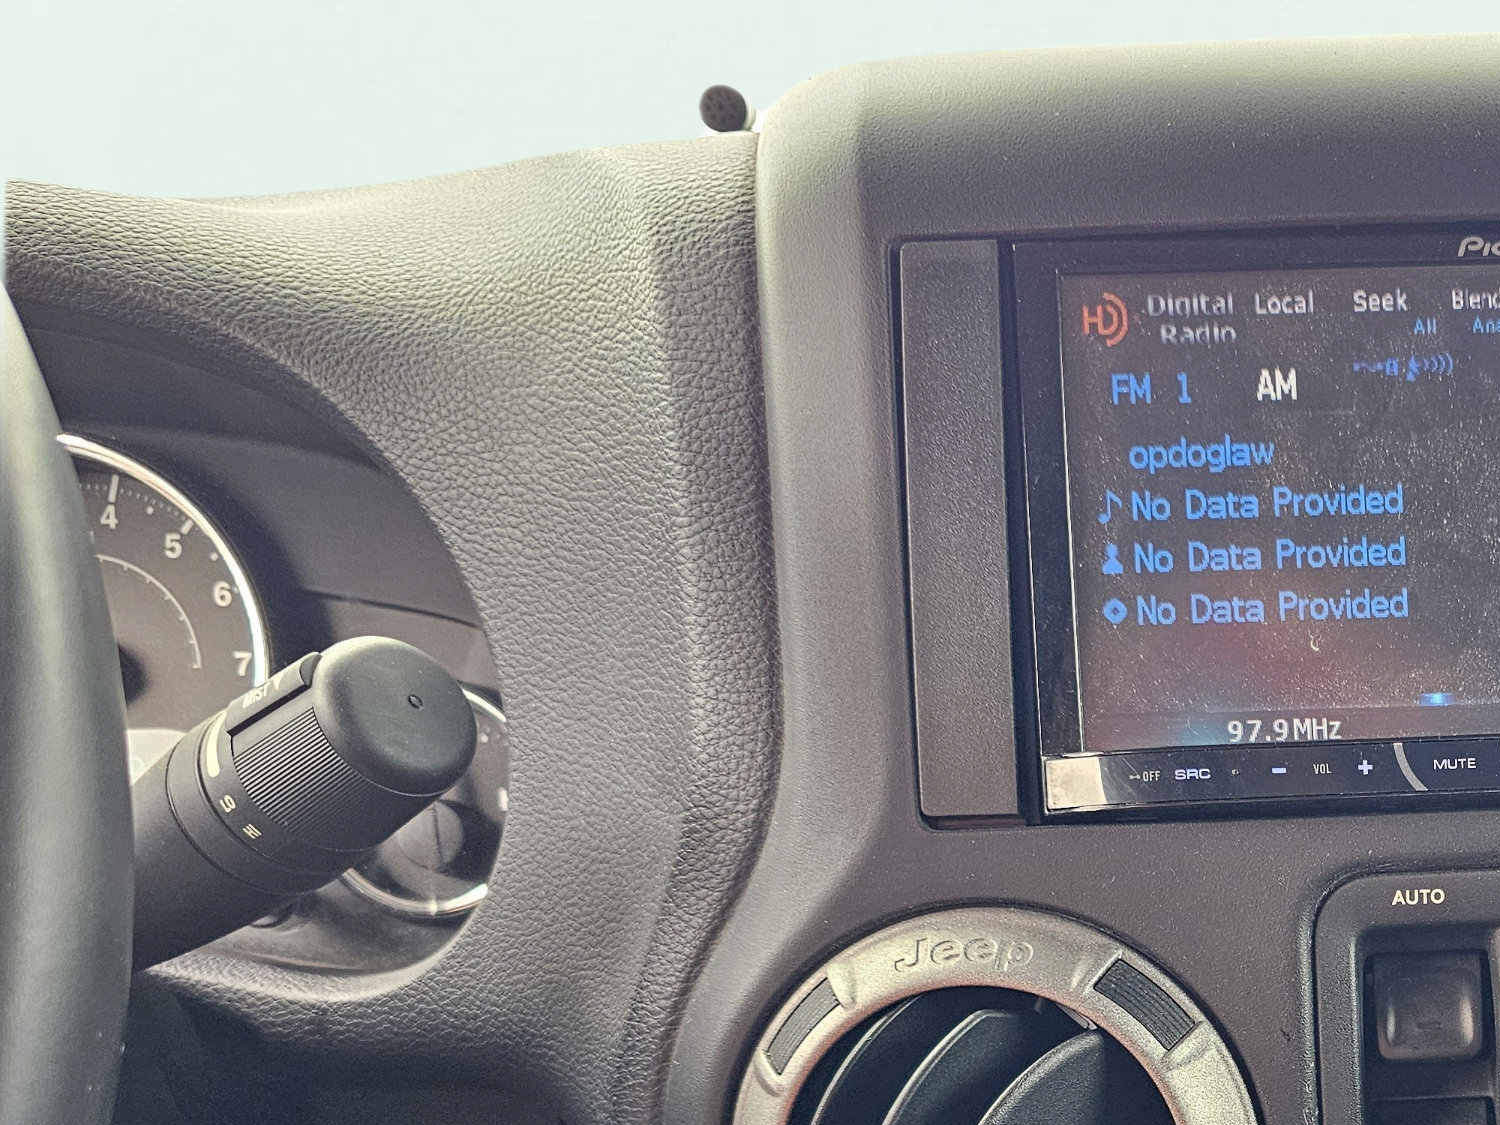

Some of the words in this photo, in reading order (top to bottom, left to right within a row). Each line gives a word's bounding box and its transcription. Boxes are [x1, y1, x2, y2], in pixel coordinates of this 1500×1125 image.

[1254, 291, 1314, 315] Local
[1353, 287, 1408, 312] Seek
[1413, 318, 1437, 335] All
[1111, 371, 1152, 405] FM
[1176, 371, 1192, 404] 1
[1256, 365, 1298, 401] AM
[1128, 433, 1275, 474] opdoglaw
[1131, 488, 1171, 521] No
[1185, 487, 1259, 520] Data
[1273, 481, 1404, 517] Provided
[101, 504, 118, 529] 4
[164, 533, 182, 559] 5
[1134, 541, 1174, 574] No
[1188, 540, 1262, 572] Data
[1276, 535, 1406, 569] Provided
[213, 581, 232, 607] 6
[1137, 594, 1176, 626] No
[1191, 592, 1265, 623] Data
[1279, 587, 1409, 621] Provided
[232, 651, 252, 676] 7
[1142, 771, 1161, 782] OFF
[1175, 769, 1211, 780] SRC
[1312, 763, 1332, 774] VOL
[1433, 758, 1476, 770] MUTE
[219, 794, 237, 813] LO
[1392, 888, 1445, 906] AUTO
[894, 937, 1034, 973] Jeep
